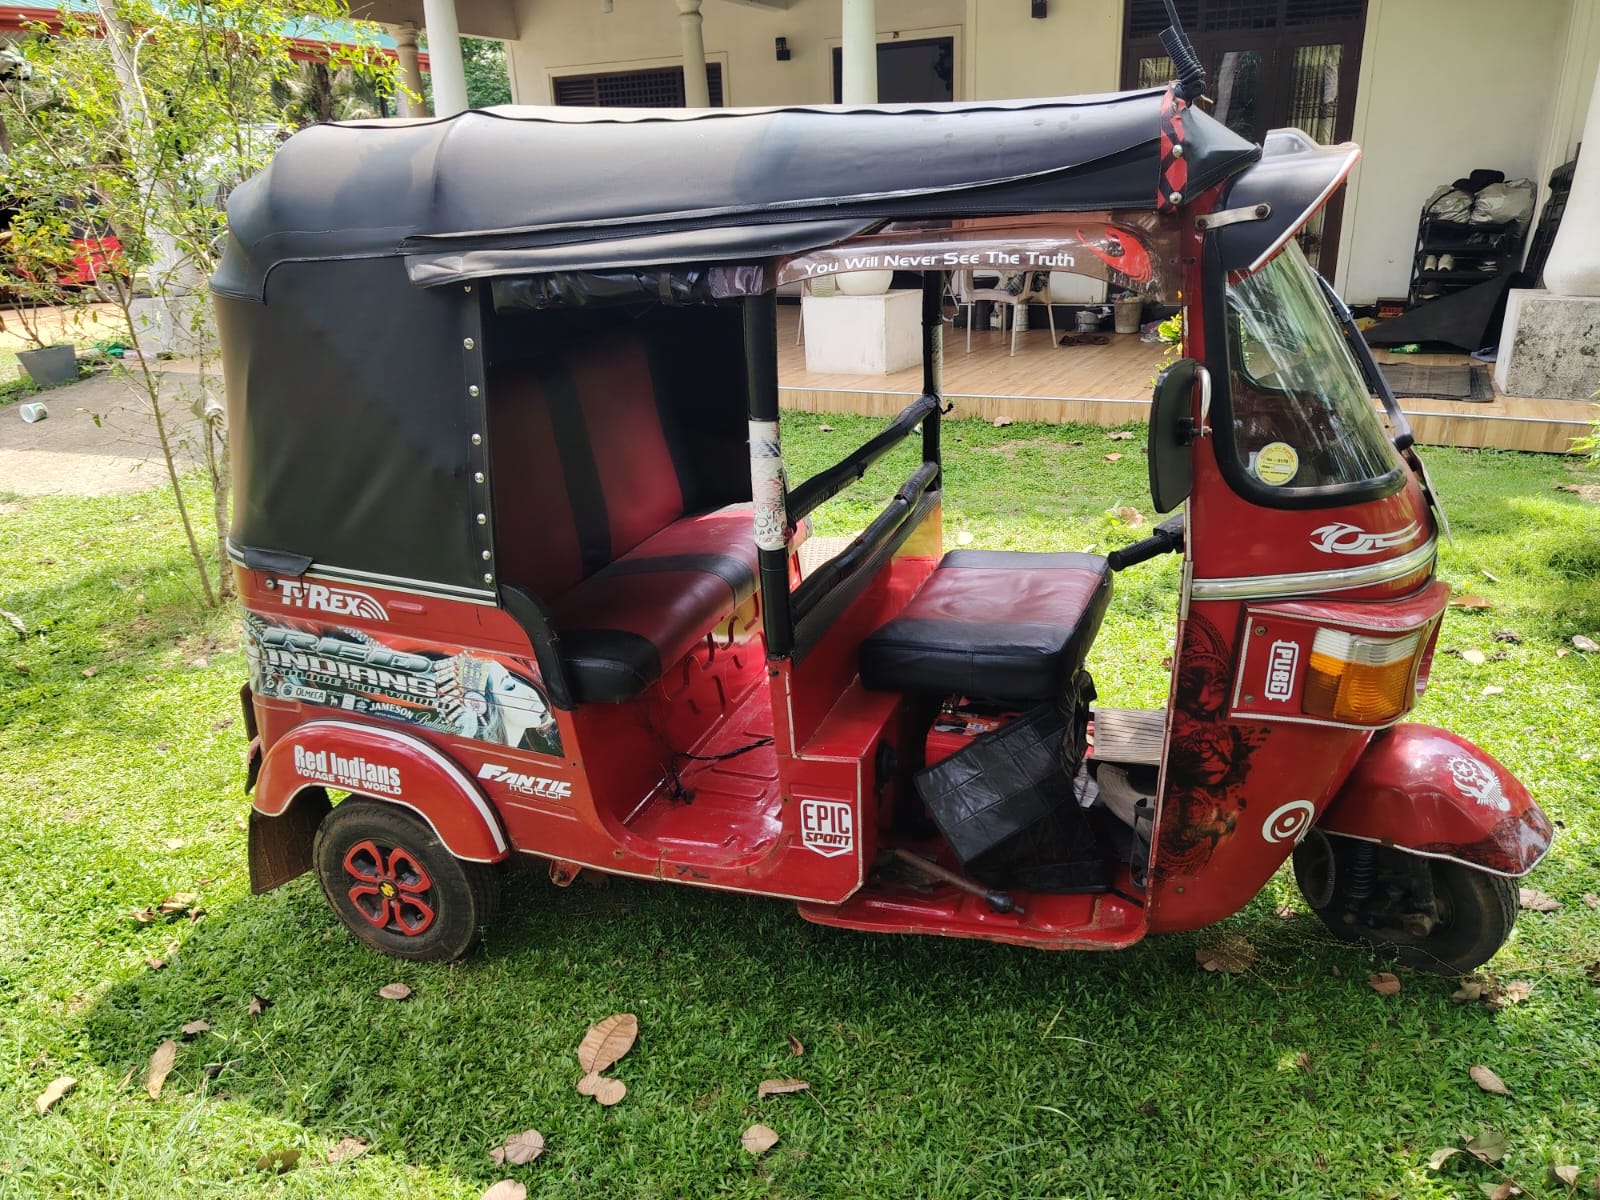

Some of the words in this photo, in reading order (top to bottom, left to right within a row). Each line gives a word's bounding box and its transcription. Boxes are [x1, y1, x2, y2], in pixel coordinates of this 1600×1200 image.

[805, 262, 838, 276] You
[845, 256, 878, 270] Will
[883, 255, 936, 267] Never
[943, 251, 980, 265] See
[985, 251, 1020, 265] The
[1025, 251, 1075, 267] Truth
[261, 626, 434, 675] RED
[266, 648, 438, 699] INDIANS
[1270, 647, 1294, 694] PUBG
[295, 687, 325, 701] OLMECA
[369, 702, 415, 720] JAMESON
[294, 744, 328, 773] Red
[330, 752, 400, 787] Indians
[295, 766, 336, 783] VOYAGE
[337, 775, 360, 787] THE
[362, 780, 402, 795] WORLD
[477, 763, 573, 795] FANTIC
[802, 803, 850, 835] EPIC
[804, 831, 852, 846] SPORT
